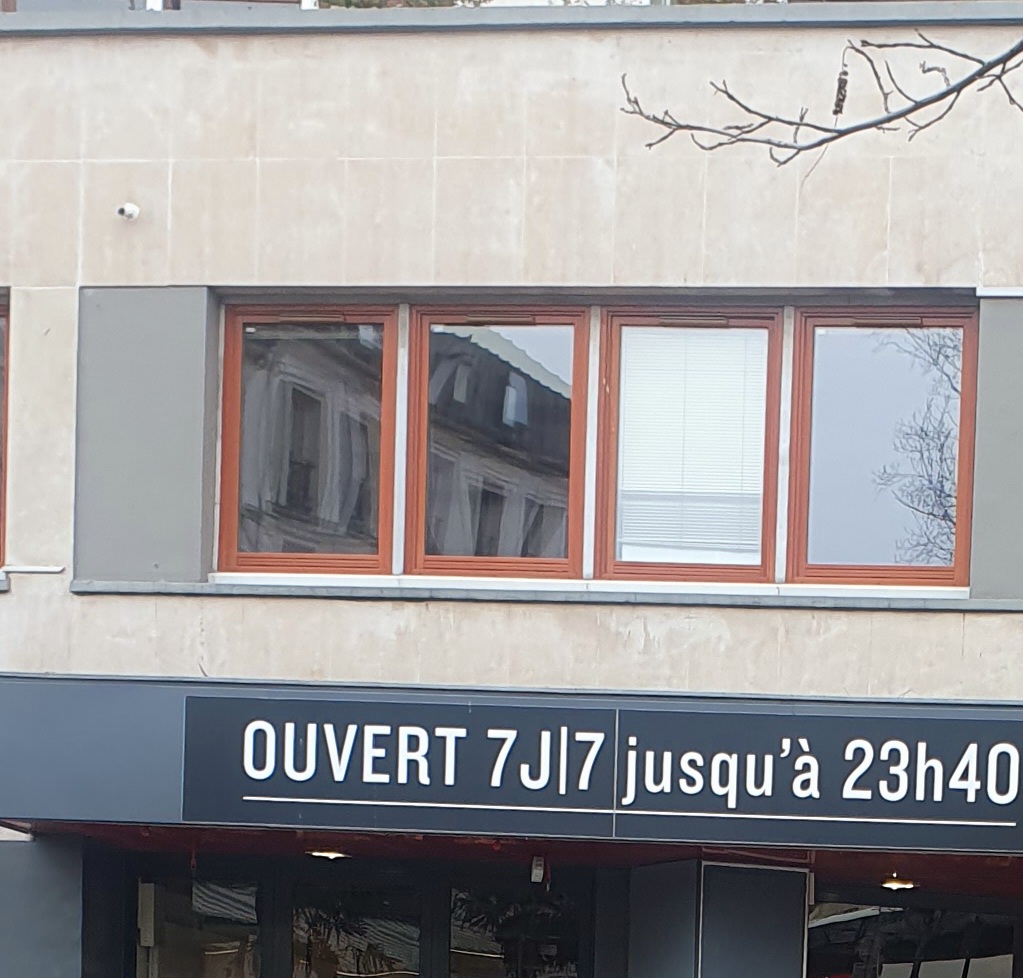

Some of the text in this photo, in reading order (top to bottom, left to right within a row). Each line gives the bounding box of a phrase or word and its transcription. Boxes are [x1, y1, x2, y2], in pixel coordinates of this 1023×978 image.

[242, 719, 467, 786] OUVERT
[621, 736, 820, 809] jusqu'à
[841, 739, 1021, 806] 23h40
